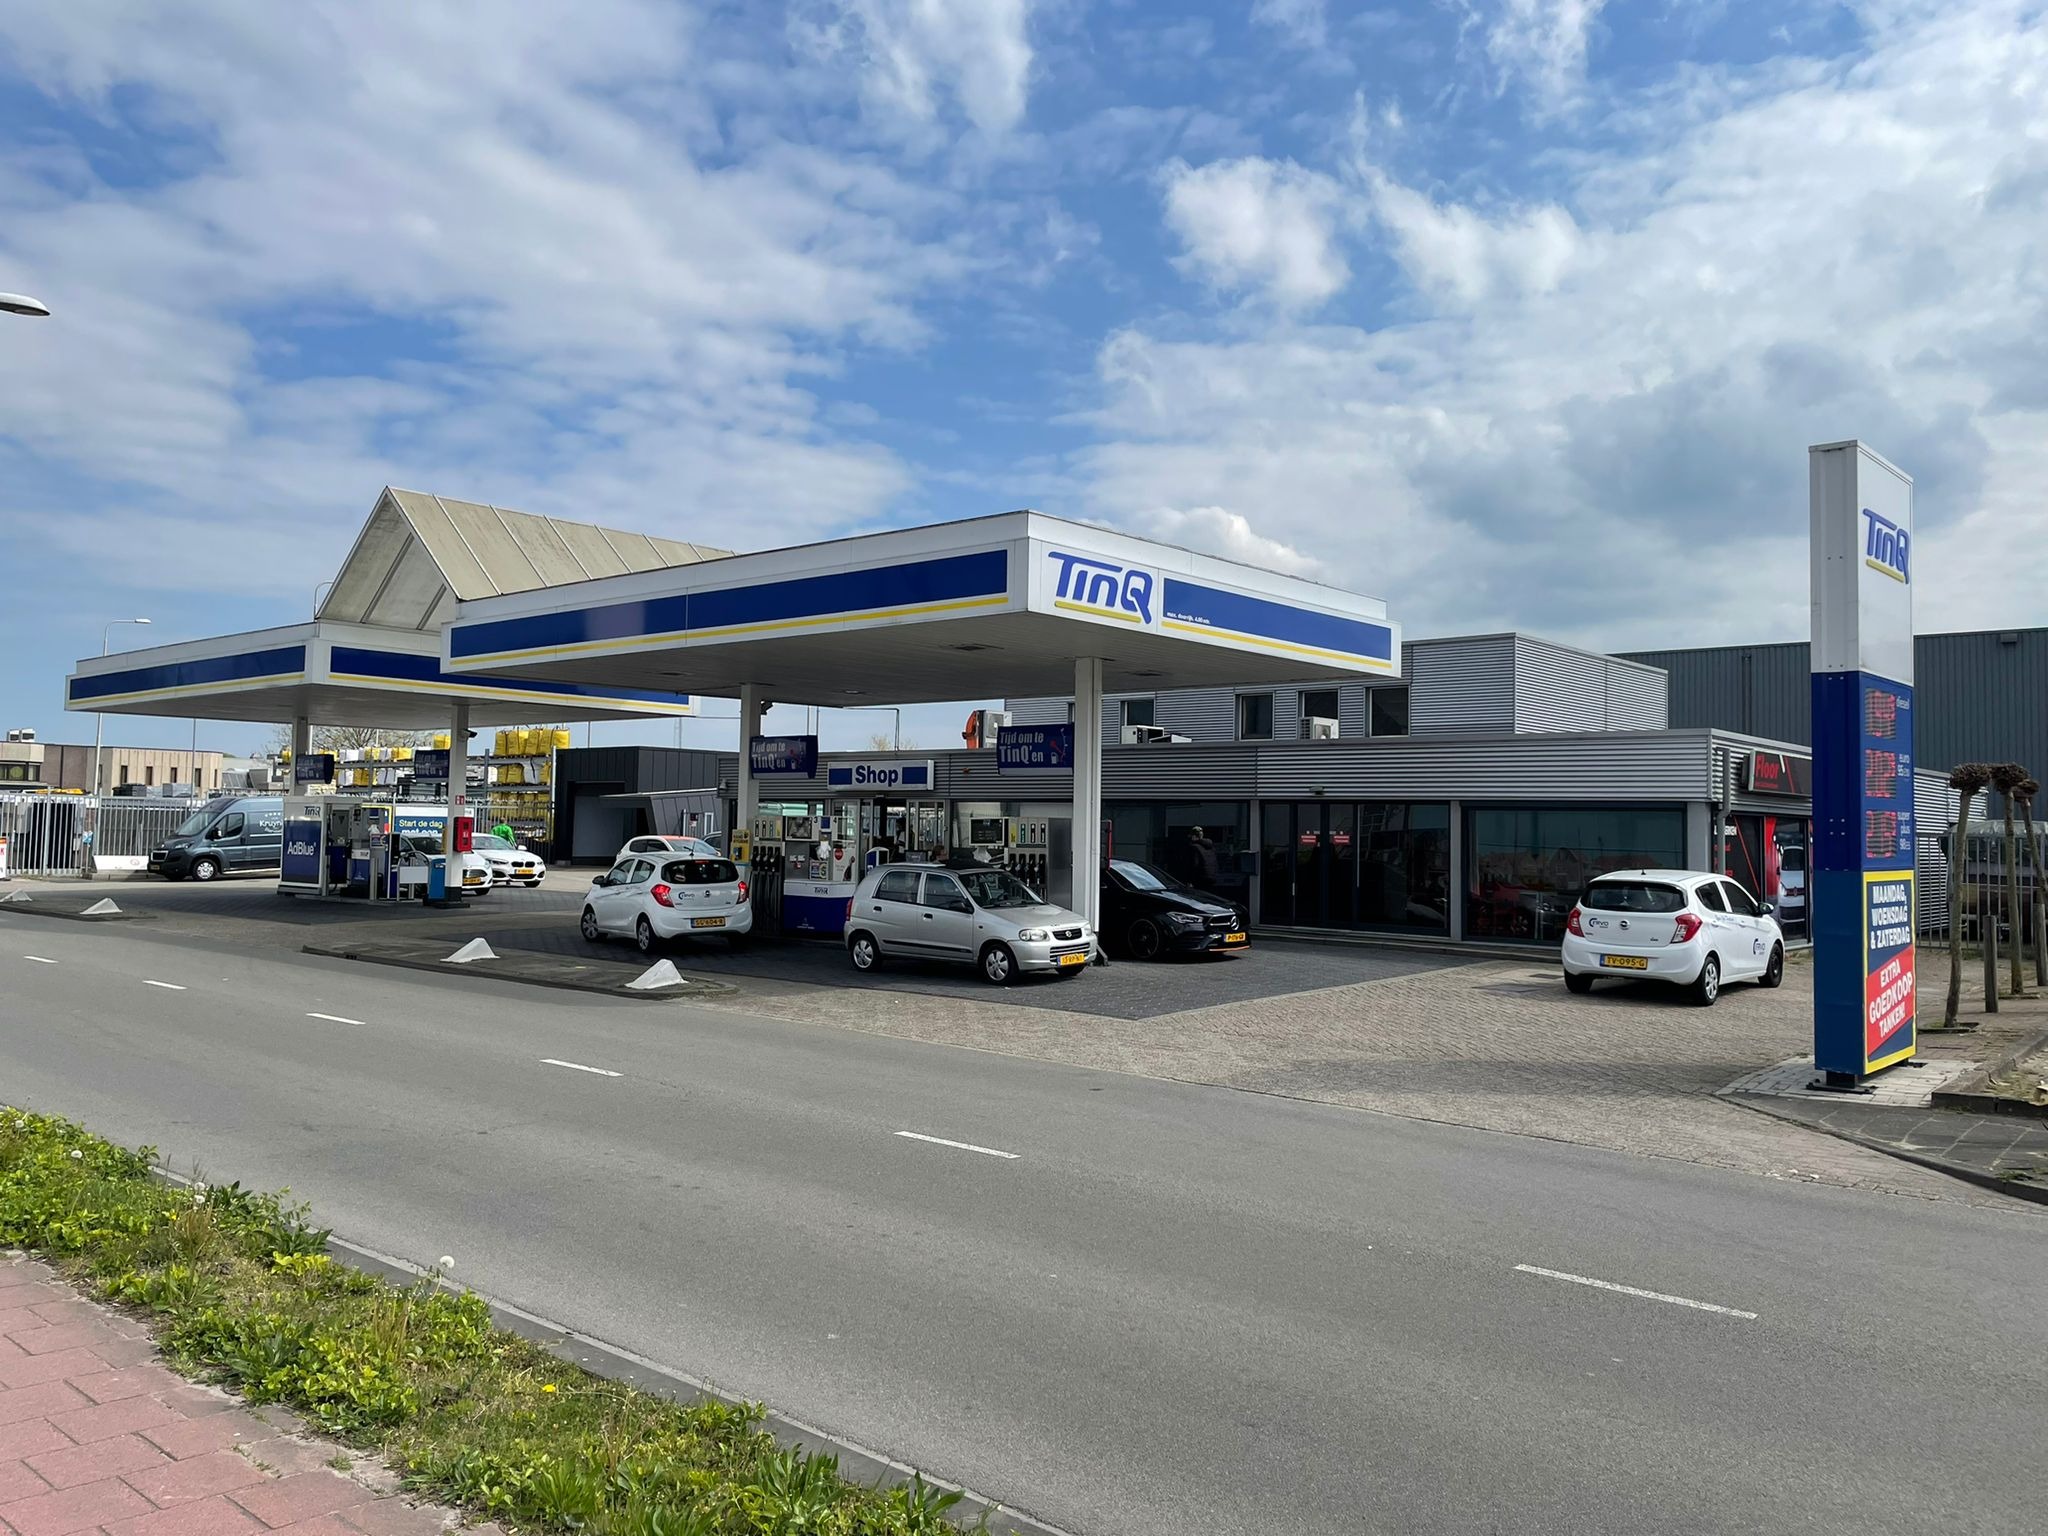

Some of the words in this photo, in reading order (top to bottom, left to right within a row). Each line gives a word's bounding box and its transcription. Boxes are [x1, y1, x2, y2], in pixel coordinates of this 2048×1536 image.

[1862, 508, 1909, 584] TinQ
[1048, 551, 1153, 624] TinQ
[752, 741, 767, 753] Tijd
[767, 742, 778, 751] om
[778, 741, 786, 751] te
[1000, 732, 1017, 744] Tijd
[1018, 732, 1033, 743] om
[1034, 732, 1044, 743] te
[999, 745, 1044, 764] TinQ'en
[855, 765, 899, 787] Shop
[1755, 753, 1779, 779] Floor
[259, 820, 283, 829] Kruyn
[429, 820, 443, 828] dag
[1872, 885, 1907, 904] MAANDAG,
[1871, 906, 1908, 927] WOENSDAG
[1870, 931, 1876, 949] &
[1877, 928, 1911, 949] ZATERDAG
[1607, 956, 1645, 967] TV-095-G
[1880, 959, 1902, 988] EXTRA
[1869, 972, 1913, 1024] GOEDKOOP
[1878, 1001, 1906, 1038] TANKEN!
